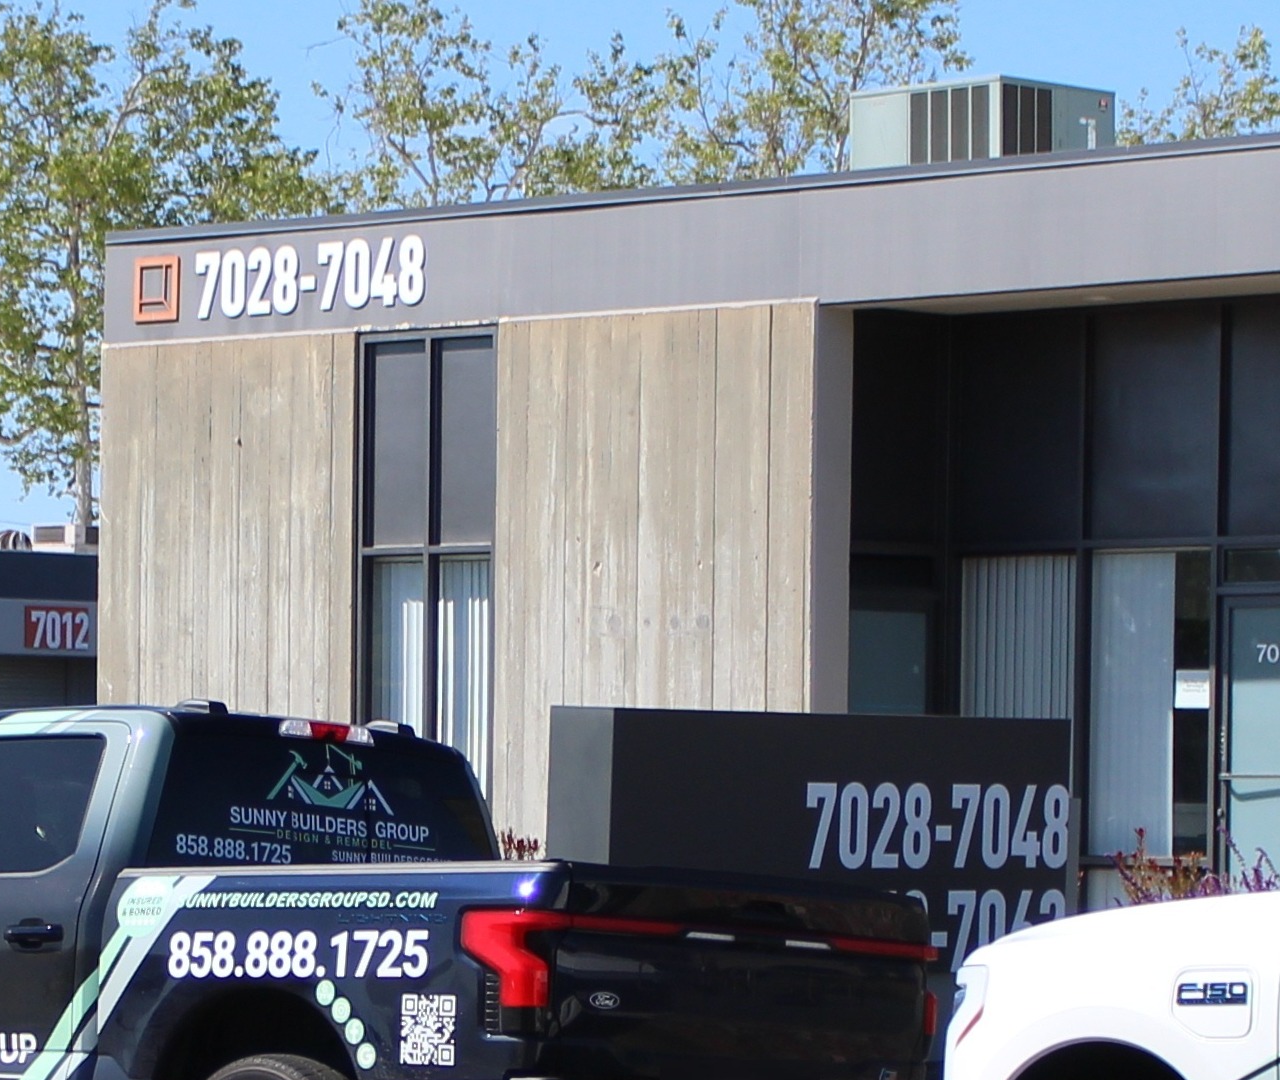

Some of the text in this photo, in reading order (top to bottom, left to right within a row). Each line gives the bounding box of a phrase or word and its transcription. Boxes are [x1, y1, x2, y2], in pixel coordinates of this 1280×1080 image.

[195, 235, 424, 319] 7028-7048
[30, 610, 89, 650] 7012
[230, 806, 429, 842] SUNNY BUILDERS GROUP
[277, 829, 319, 843] DESIGN
[336, 835, 393, 850] REMODEL
[806, 782, 1070, 869] 7028-7048
[176, 833, 292, 864] 858.888.1725
[332, 851, 367, 863] SUNNY
[168, 929, 429, 978] 858.888.1725
